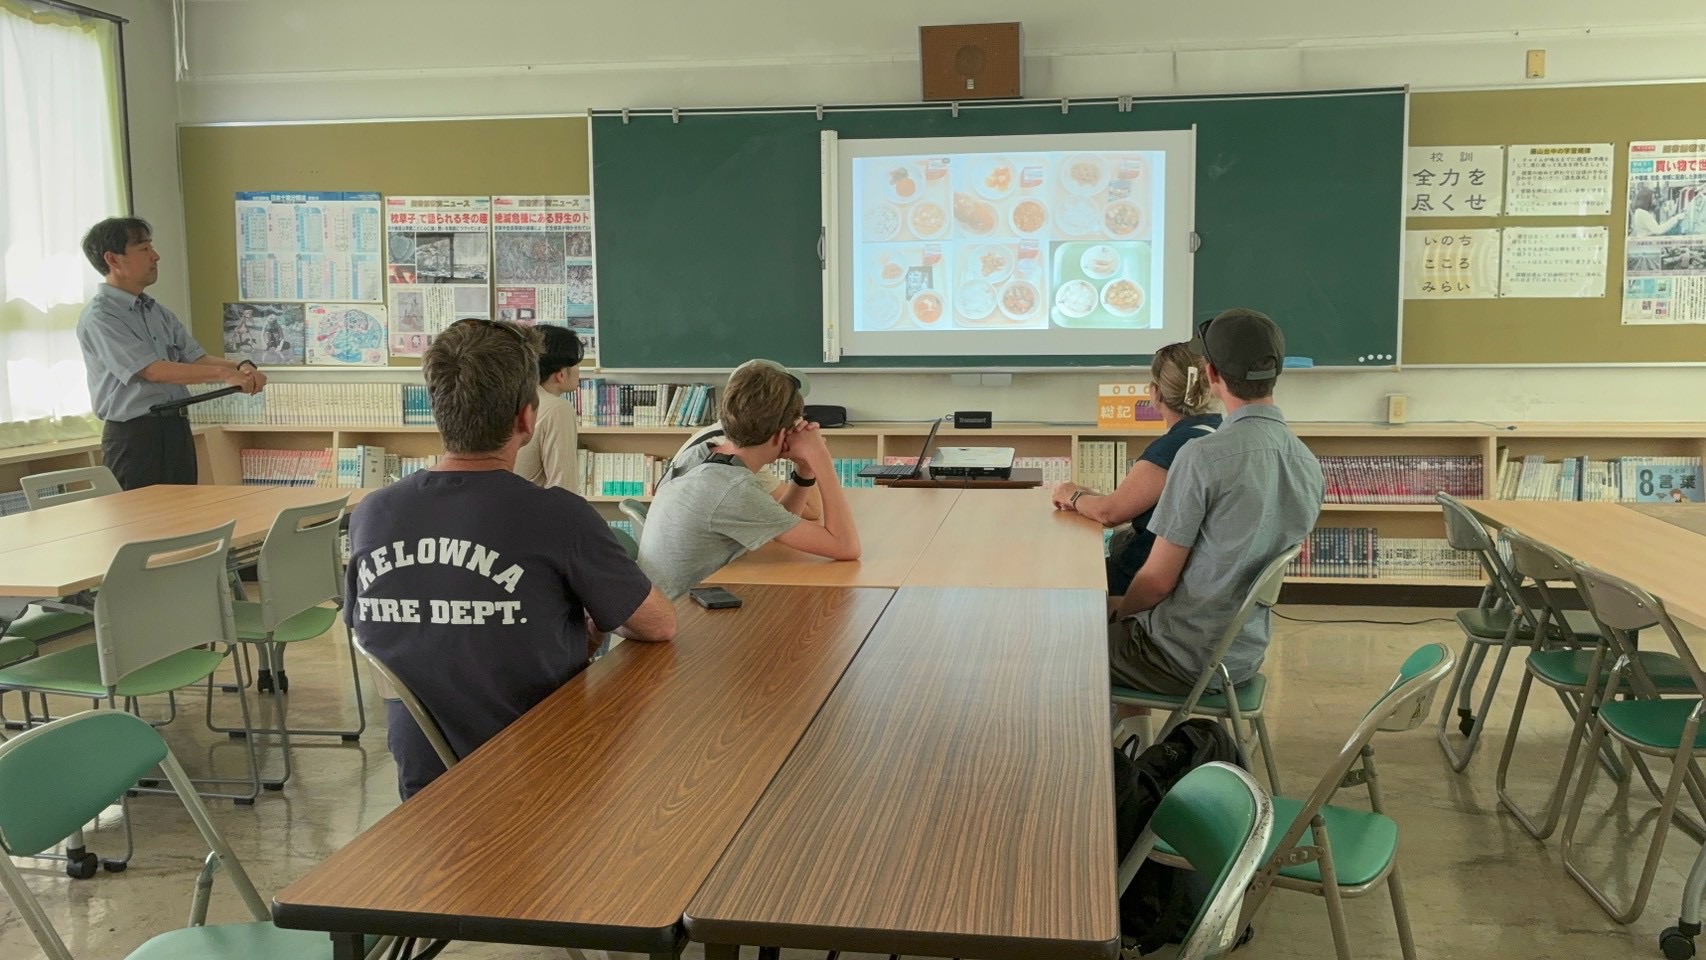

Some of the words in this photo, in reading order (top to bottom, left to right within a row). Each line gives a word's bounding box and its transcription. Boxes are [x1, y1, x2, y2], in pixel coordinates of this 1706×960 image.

[1430, 151, 1473, 162] 校訓
[1412, 168, 1486, 187] 全力を
[1411, 194, 1487, 211] 尽くせ
[1424, 235, 1471, 246] いのち
[1425, 258, 1470, 269] こころ
[1422, 281, 1471, 292] みらい
[1640, 469, 1654, 496] 8
[1659, 474, 1696, 489] 言葉
[358, 537, 525, 594] KELOWNA
[358, 597, 420, 623] FIRE
[430, 600, 527, 625] DEPT.
